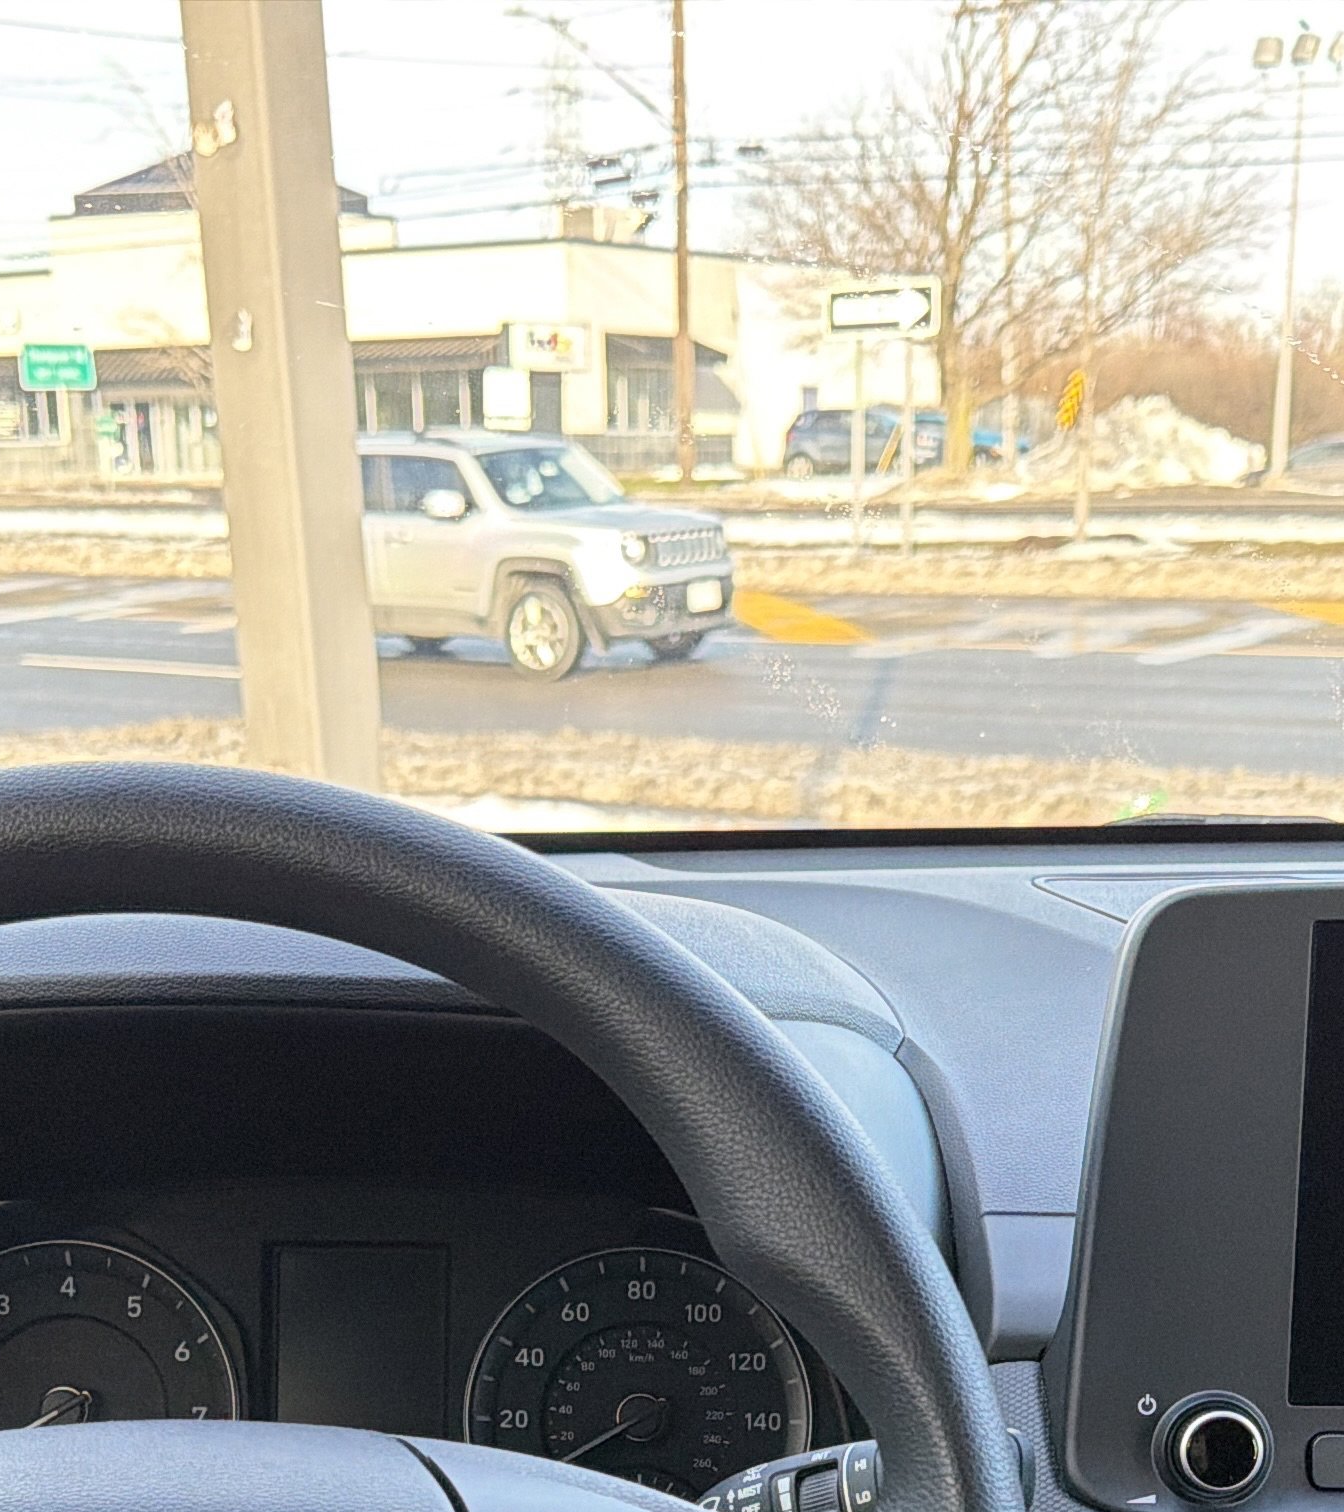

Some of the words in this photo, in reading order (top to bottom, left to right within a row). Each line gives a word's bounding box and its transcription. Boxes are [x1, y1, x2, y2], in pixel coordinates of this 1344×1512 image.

[60, 1275, 77, 1299] 4
[627, 1280, 657, 1301] 80
[127, 1295, 143, 1319] 5
[561, 1301, 590, 1323] 60
[684, 1303, 722, 1324] 100
[620, 1338, 639, 1349] 120
[174, 1340, 191, 1363] 6
[514, 1347, 545, 1369] 40
[629, 1353, 654, 1363] km/h
[581, 1361, 595, 1372] 80
[728, 1353, 766, 1372] 120
[566, 1382, 581, 1392] 60
[699, 1386, 718, 1396] 200
[191, 1405, 208, 1421] 7
[558, 1405, 573, 1415] 40
[706, 1411, 724, 1421] 220
[499, 1409, 529, 1429] 20
[744, 1412, 782, 1432] 140
[560, 1431, 574, 1441] 20
[703, 1434, 722, 1444] 240
[692, 1458, 712, 1468] 260
[854, 1458, 867, 1472] HI
[737, 1483, 763, 1500] MIST
[856, 1490, 871, 1505] LO
